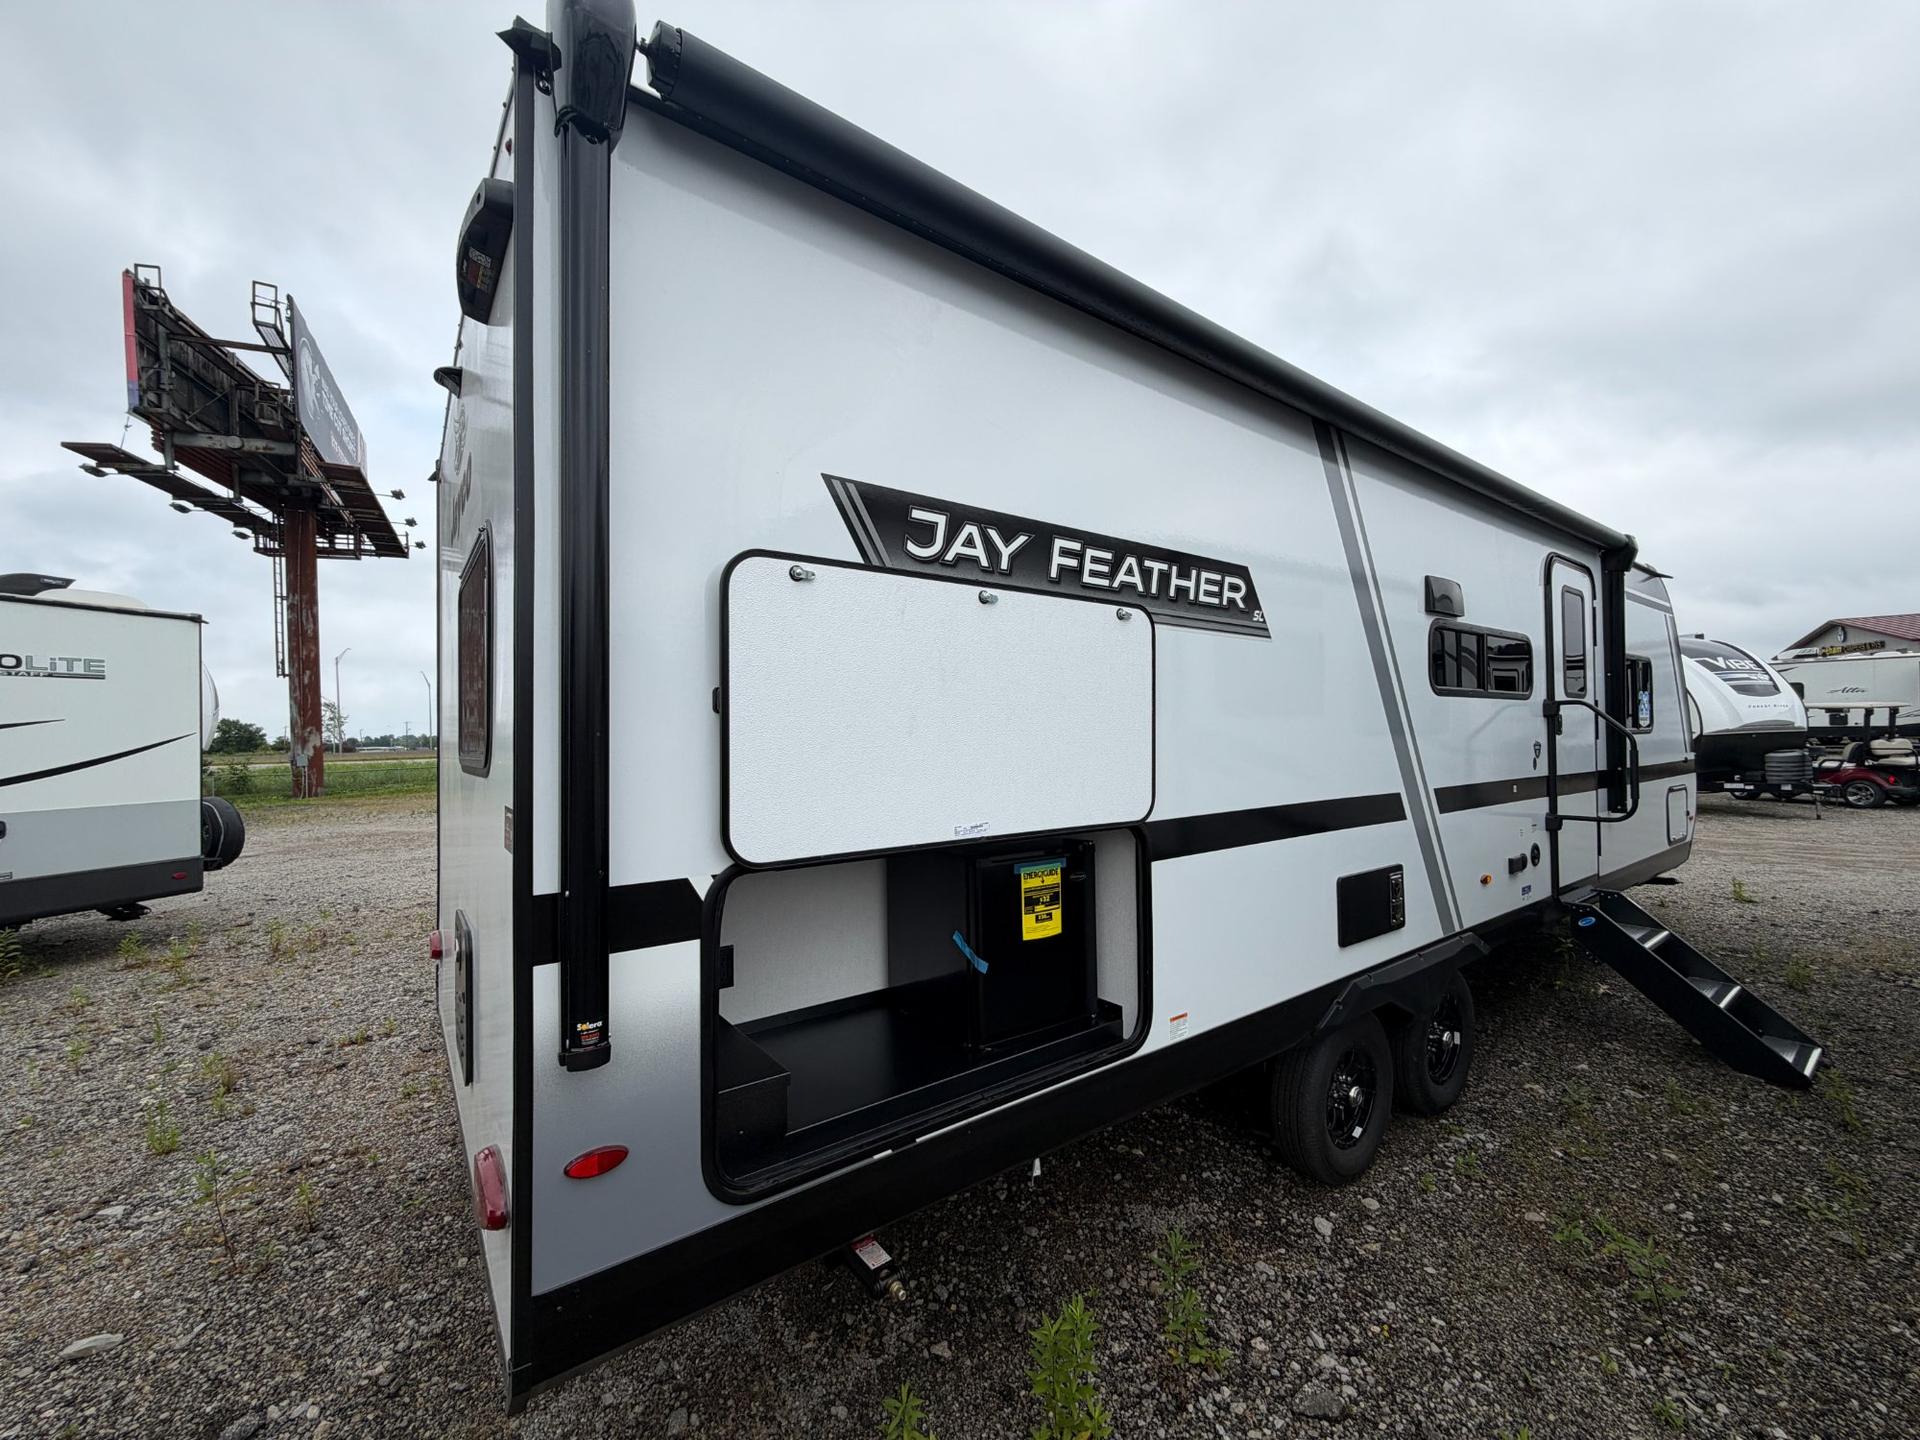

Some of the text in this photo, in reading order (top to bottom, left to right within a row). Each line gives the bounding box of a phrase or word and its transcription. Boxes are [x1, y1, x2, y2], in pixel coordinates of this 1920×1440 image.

[905, 507, 1247, 610] JAY FEATHER
[1252, 610, 1264, 622] SL
[577, 1021, 602, 1031] Solera
